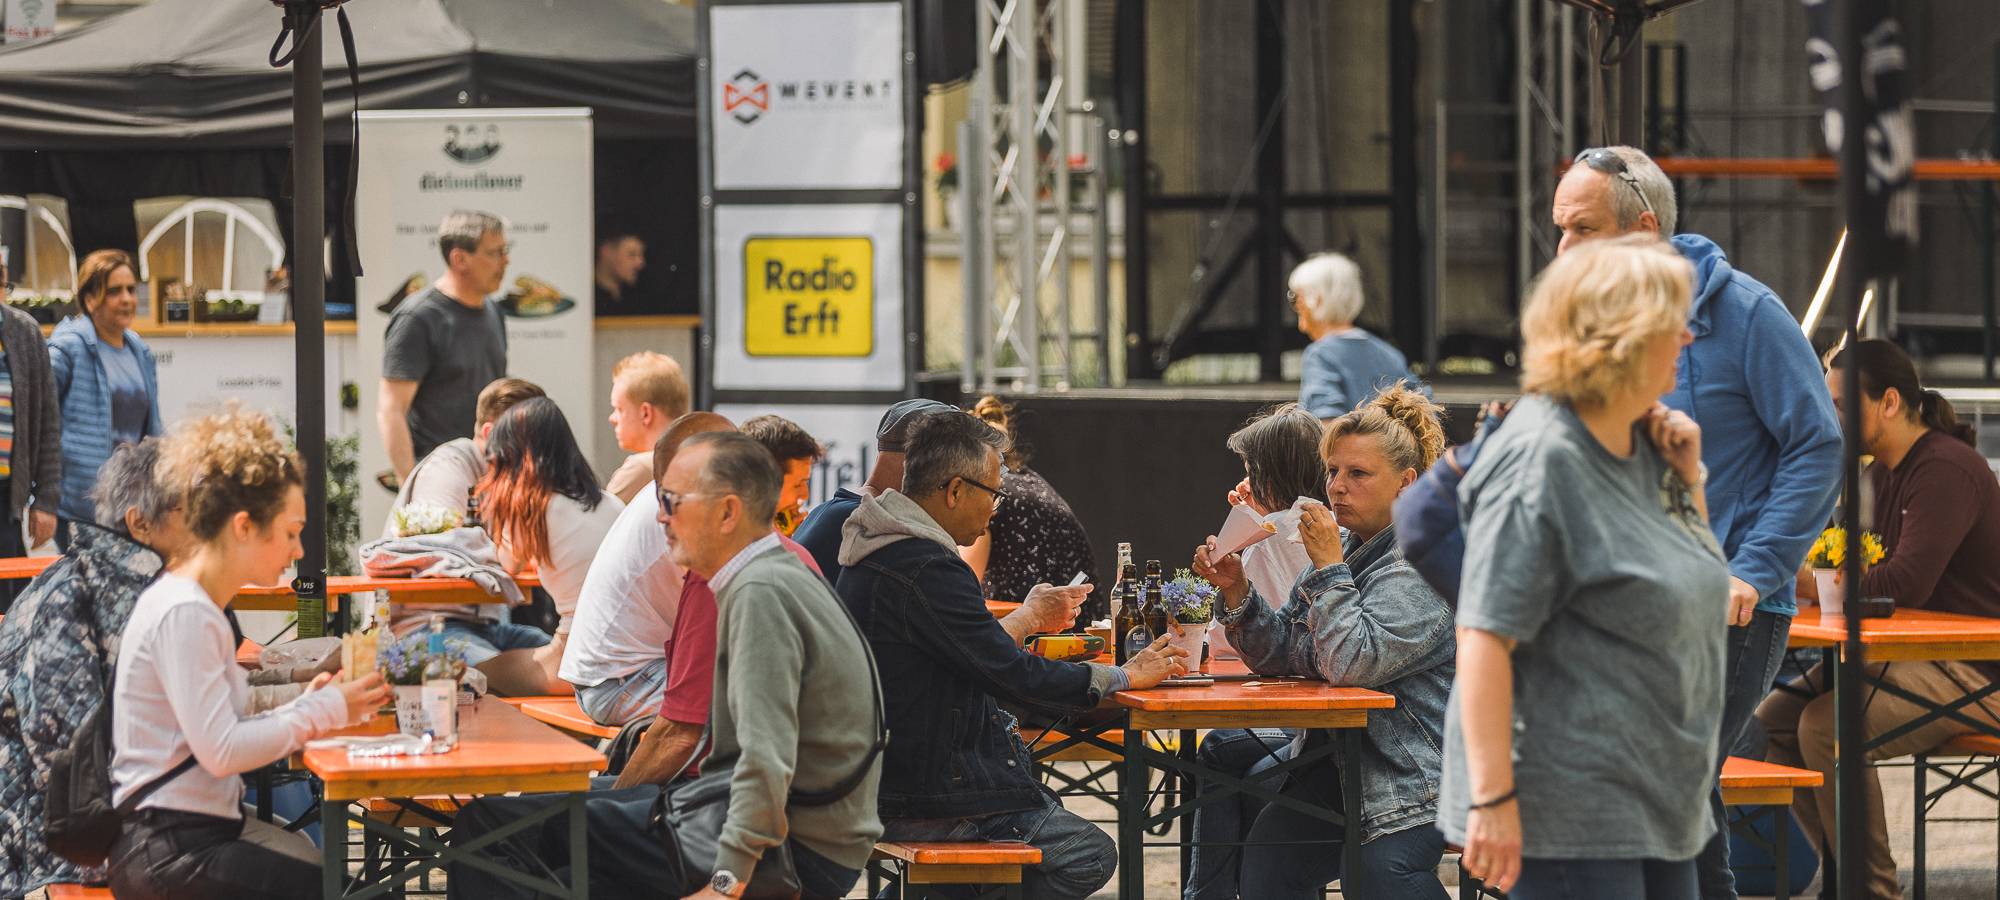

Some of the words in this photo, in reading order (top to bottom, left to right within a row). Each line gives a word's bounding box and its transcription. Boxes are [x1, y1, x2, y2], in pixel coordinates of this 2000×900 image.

[778, 80, 893, 98] WEVENT
[764, 255, 856, 293] Radio
[783, 300, 839, 336] Erft
[302, 582, 314, 590] VIS
